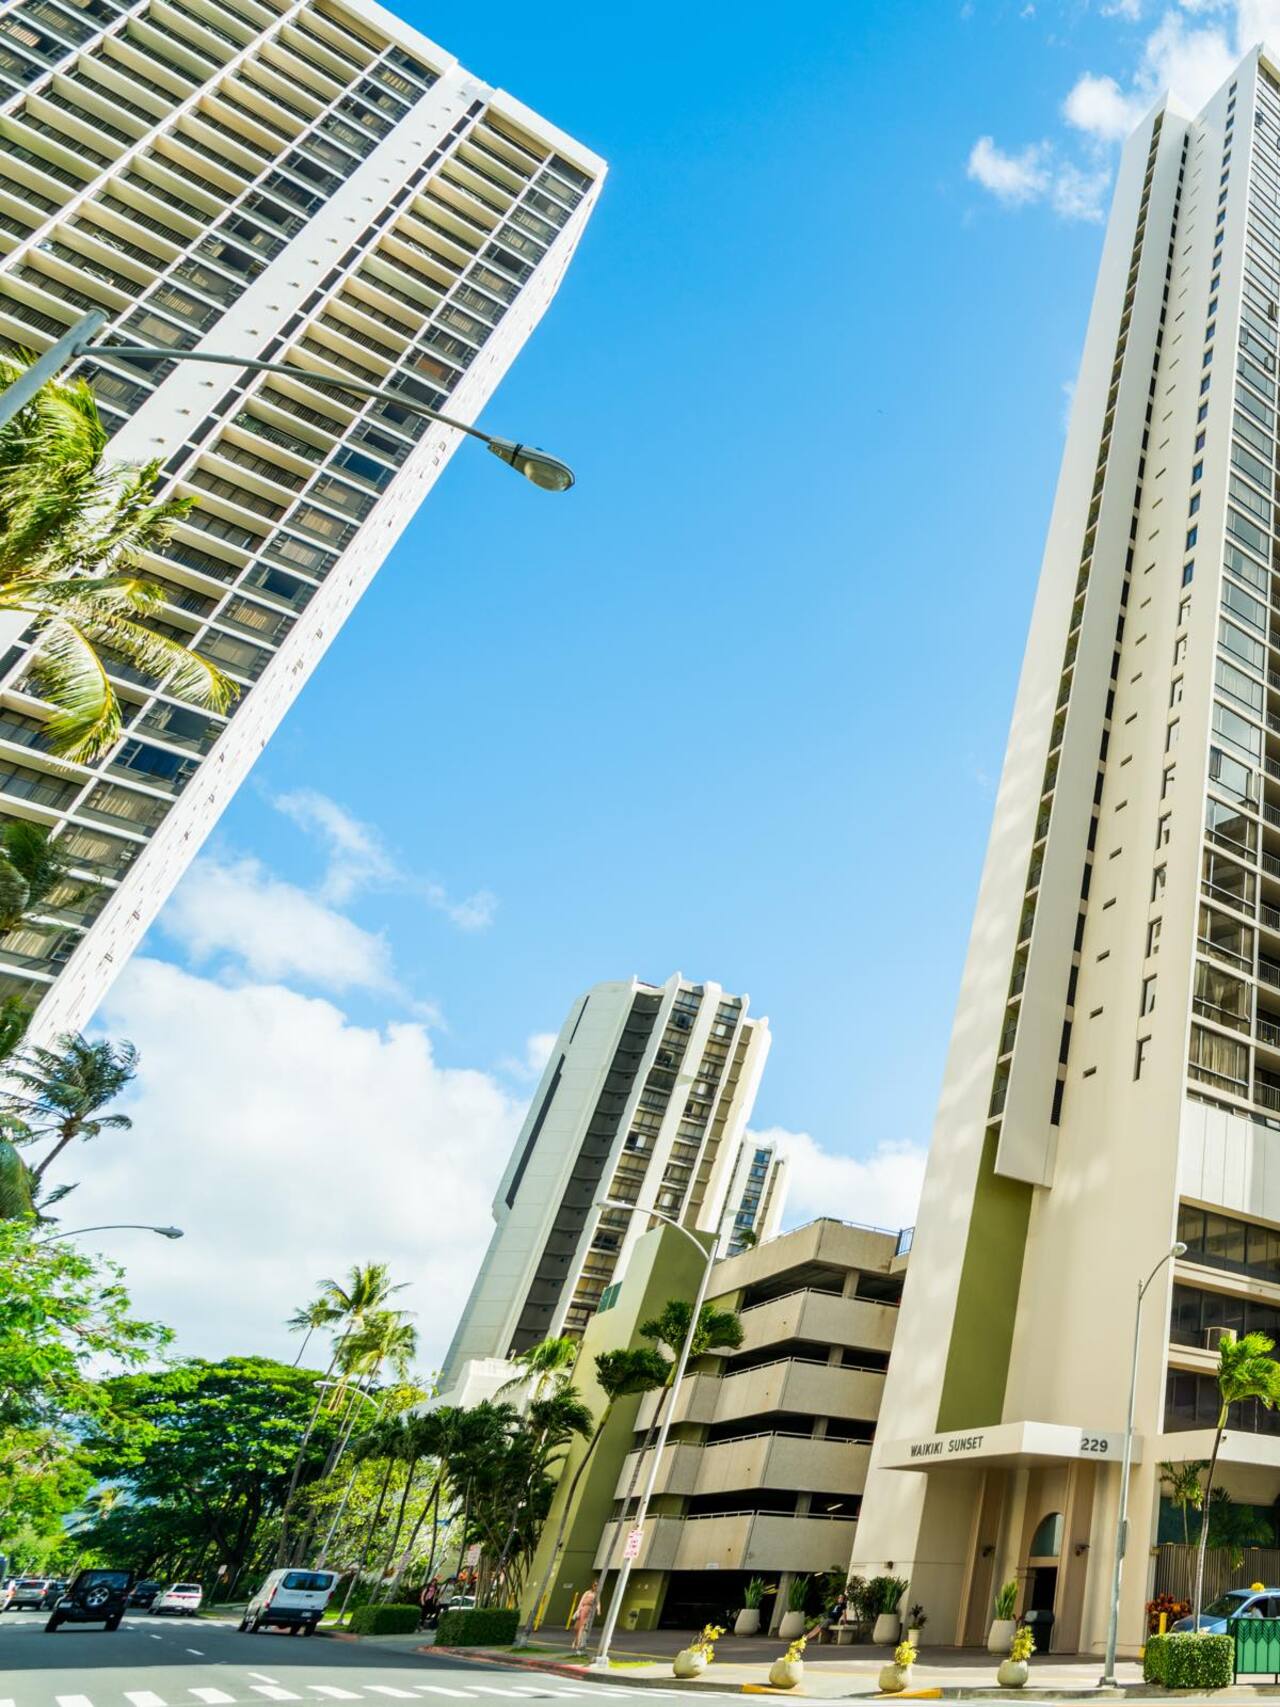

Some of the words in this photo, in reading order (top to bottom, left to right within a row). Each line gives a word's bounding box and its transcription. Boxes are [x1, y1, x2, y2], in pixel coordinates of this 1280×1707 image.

[910, 1441, 943, 1457] WAIKIKI
[948, 1435, 984, 1453] SUNSET
[1080, 1437, 1108, 1453] 229
